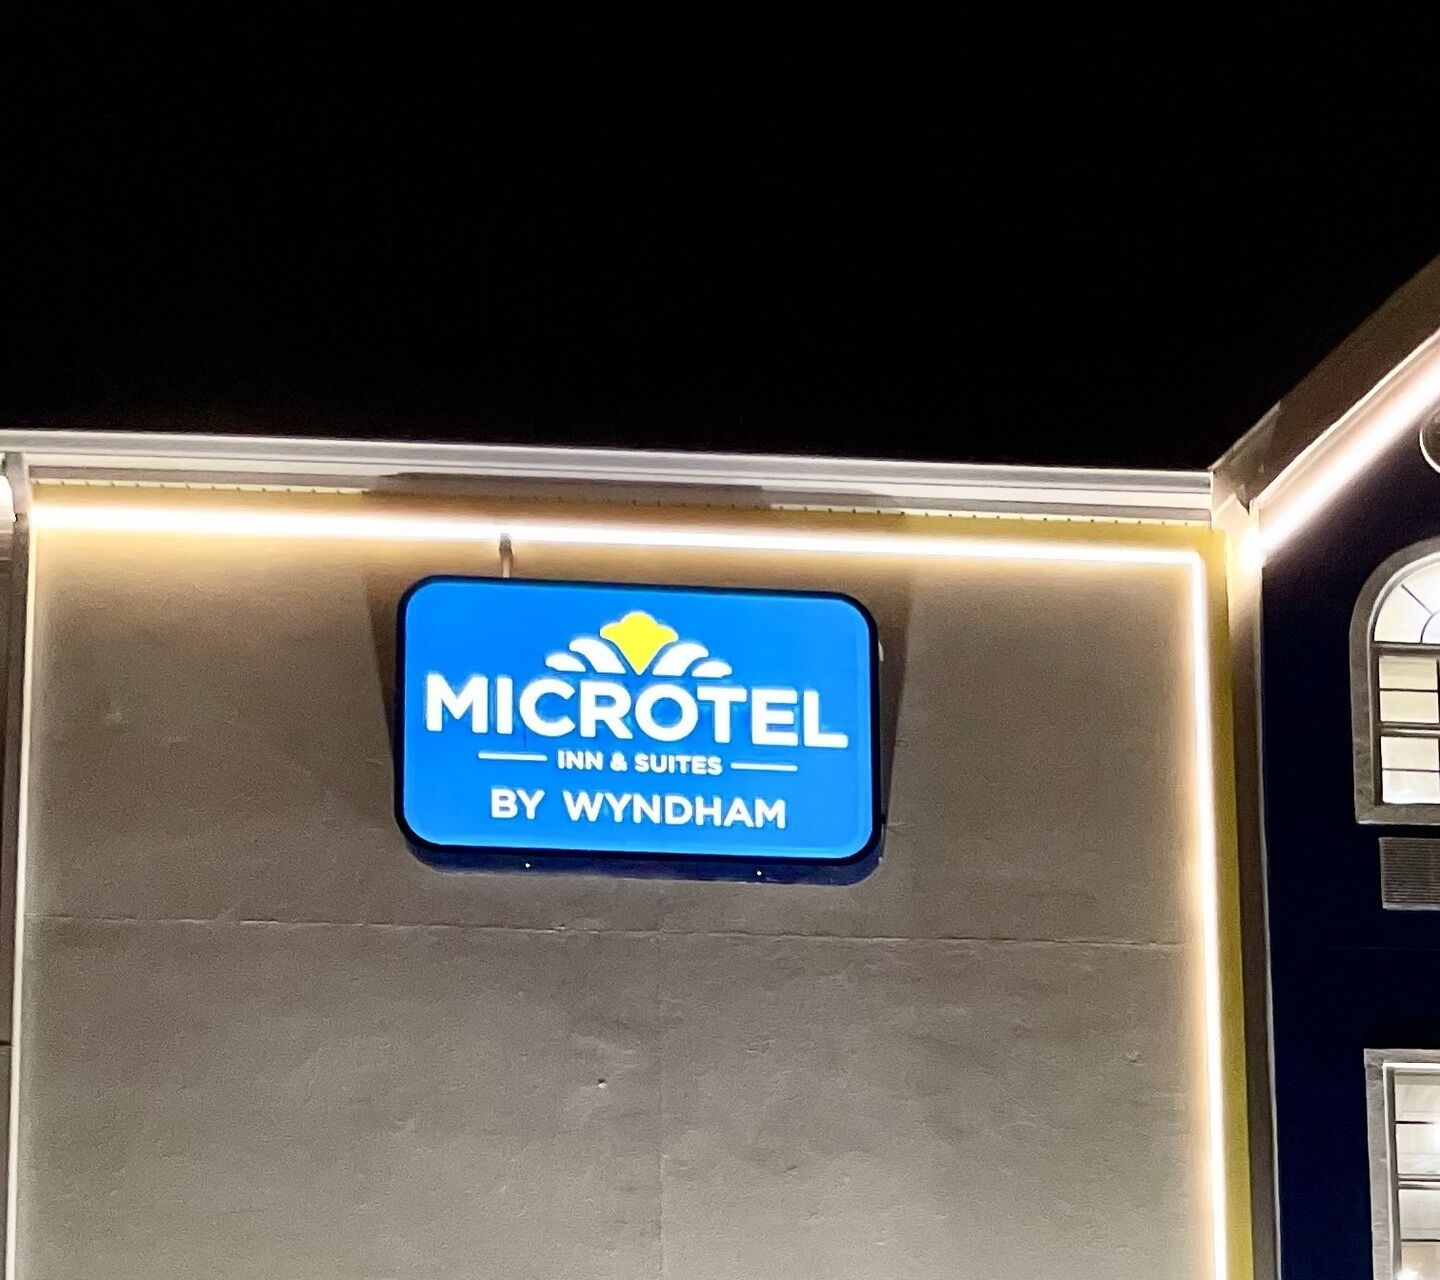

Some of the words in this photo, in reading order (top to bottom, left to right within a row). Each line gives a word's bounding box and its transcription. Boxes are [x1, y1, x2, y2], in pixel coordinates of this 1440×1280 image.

[426, 672, 849, 749] MICROTEL
[557, 750, 604, 771] INN
[609, 751, 628, 772] &
[634, 753, 723, 776] SUITES
[490, 787, 546, 820] BY
[562, 789, 786, 830] WYNDHAM
